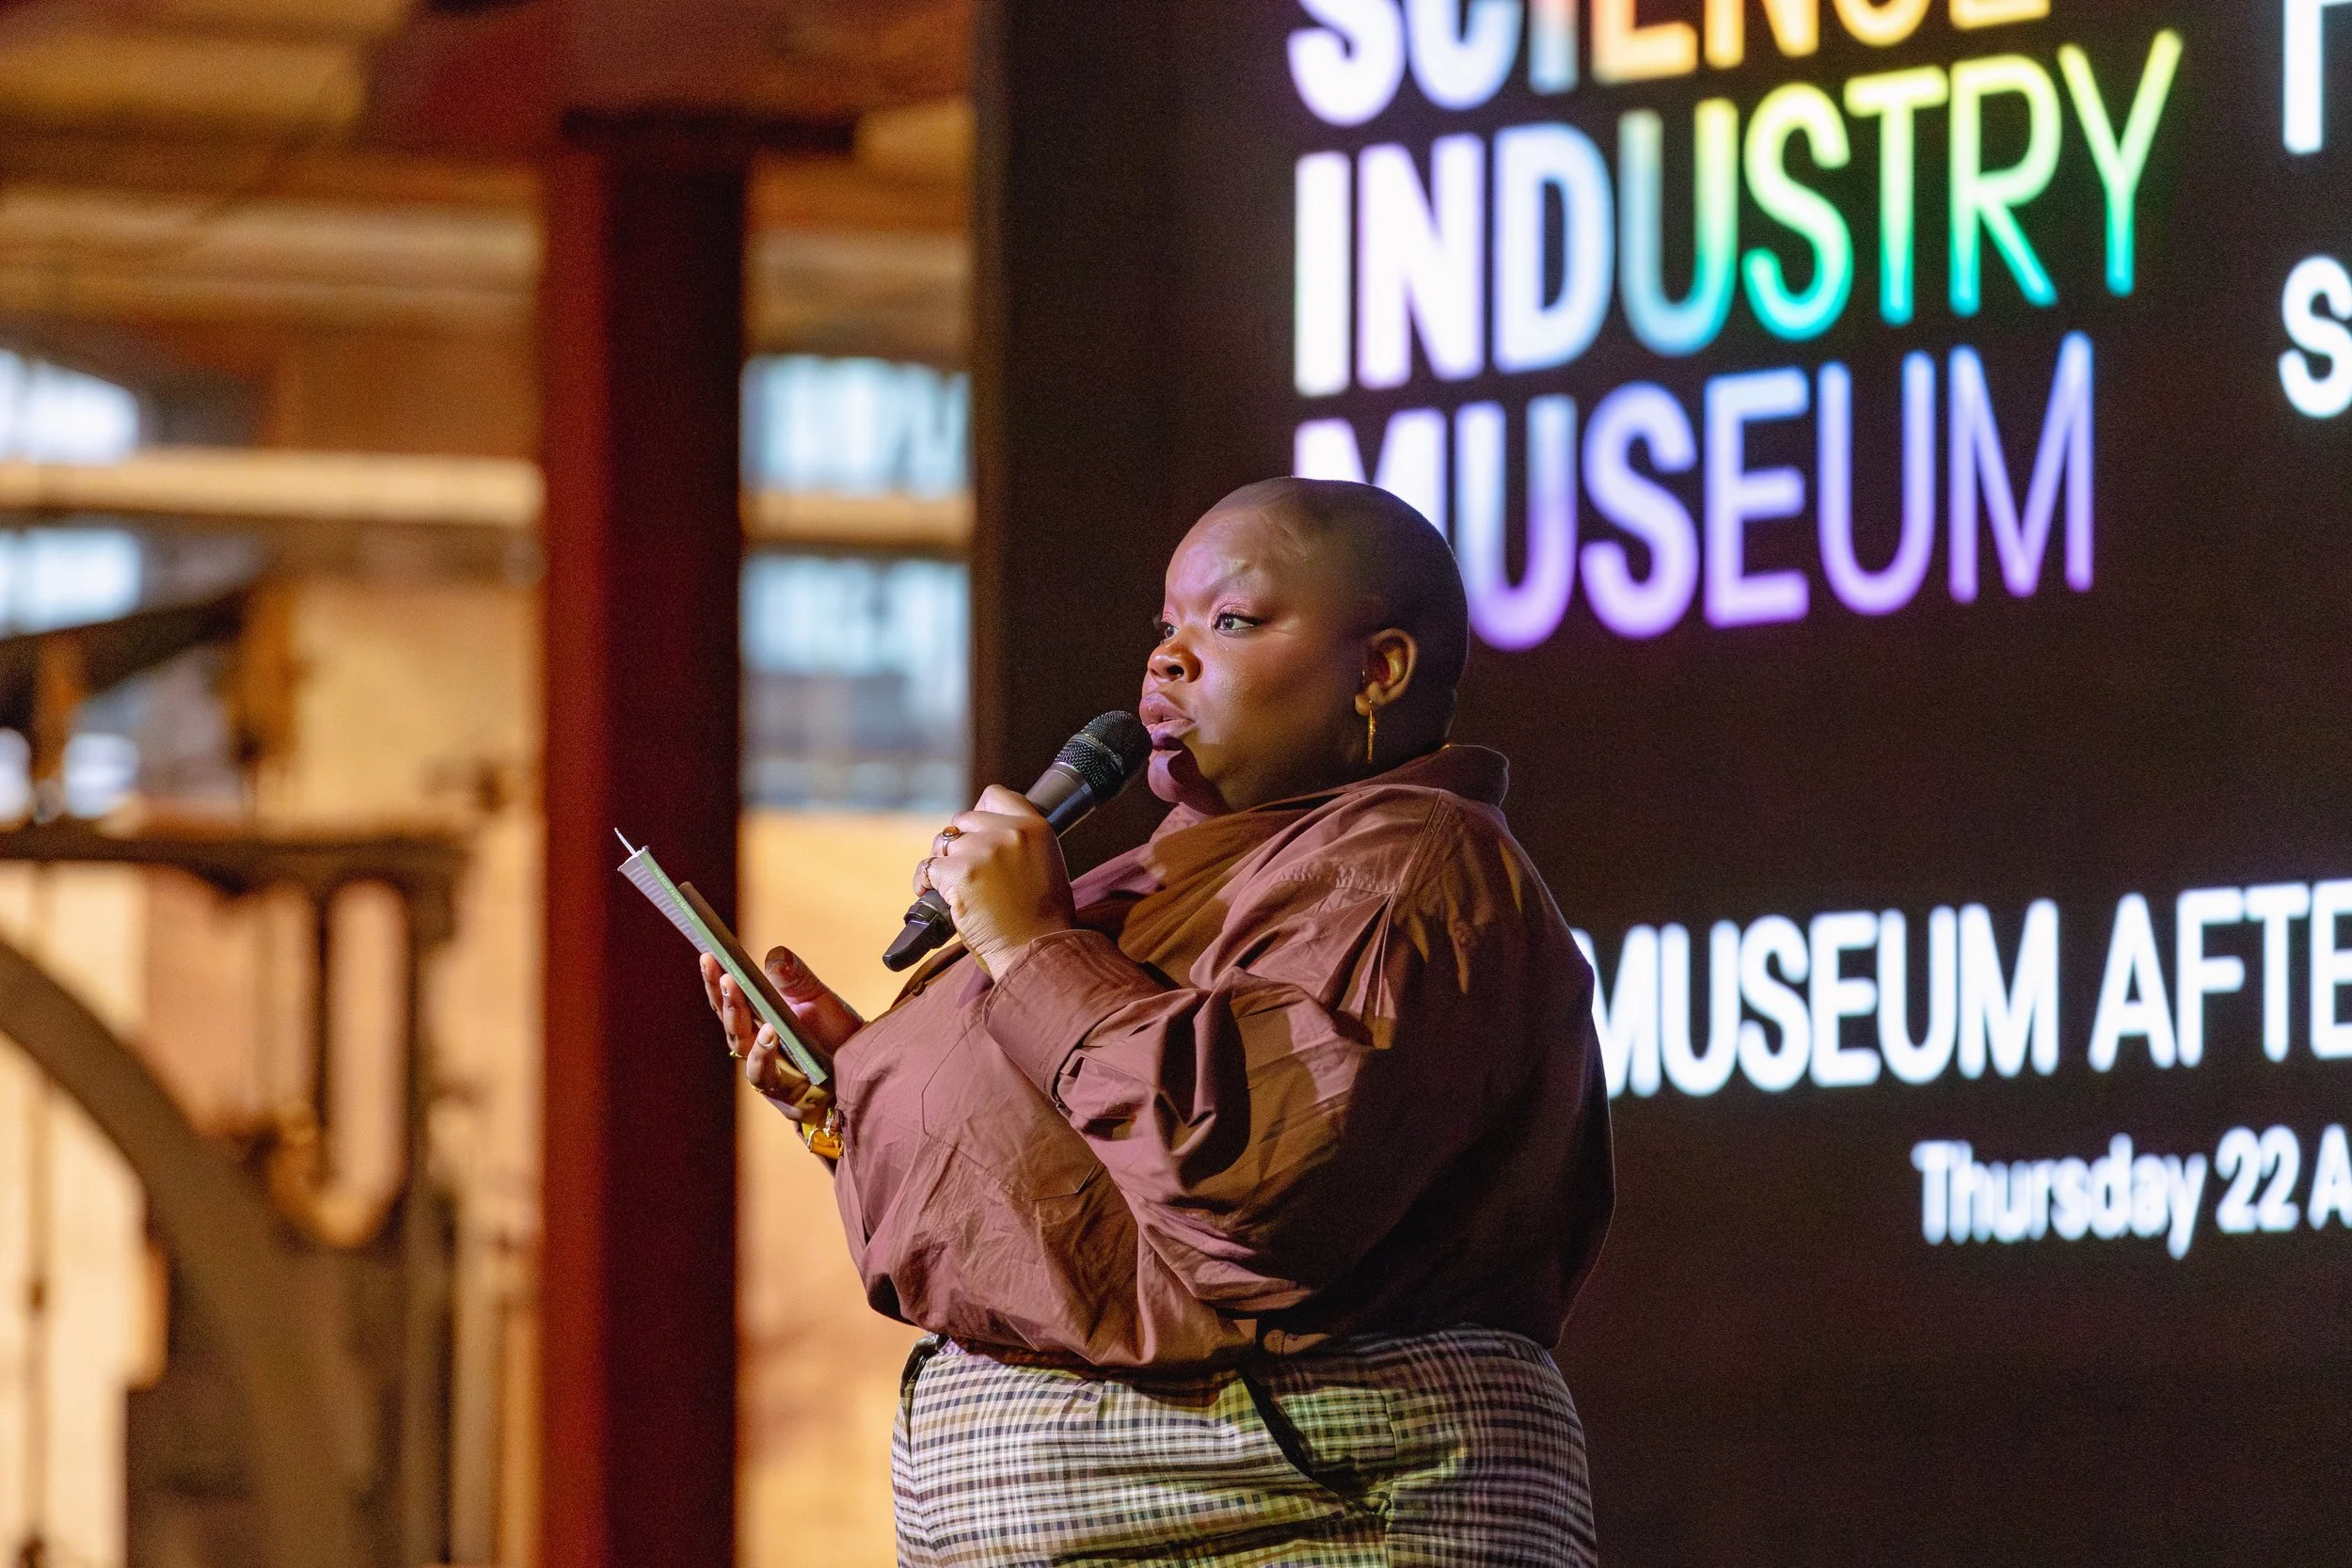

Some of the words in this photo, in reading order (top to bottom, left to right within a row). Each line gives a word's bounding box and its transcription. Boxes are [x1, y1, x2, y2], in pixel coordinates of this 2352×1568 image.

[1293, 30, 2184, 397] INDUSTRY
[2088, 878, 2352, 1072] AFTE
[1911, 1132, 2208, 1259] Thursday
[2215, 1125, 2301, 1234] 22
